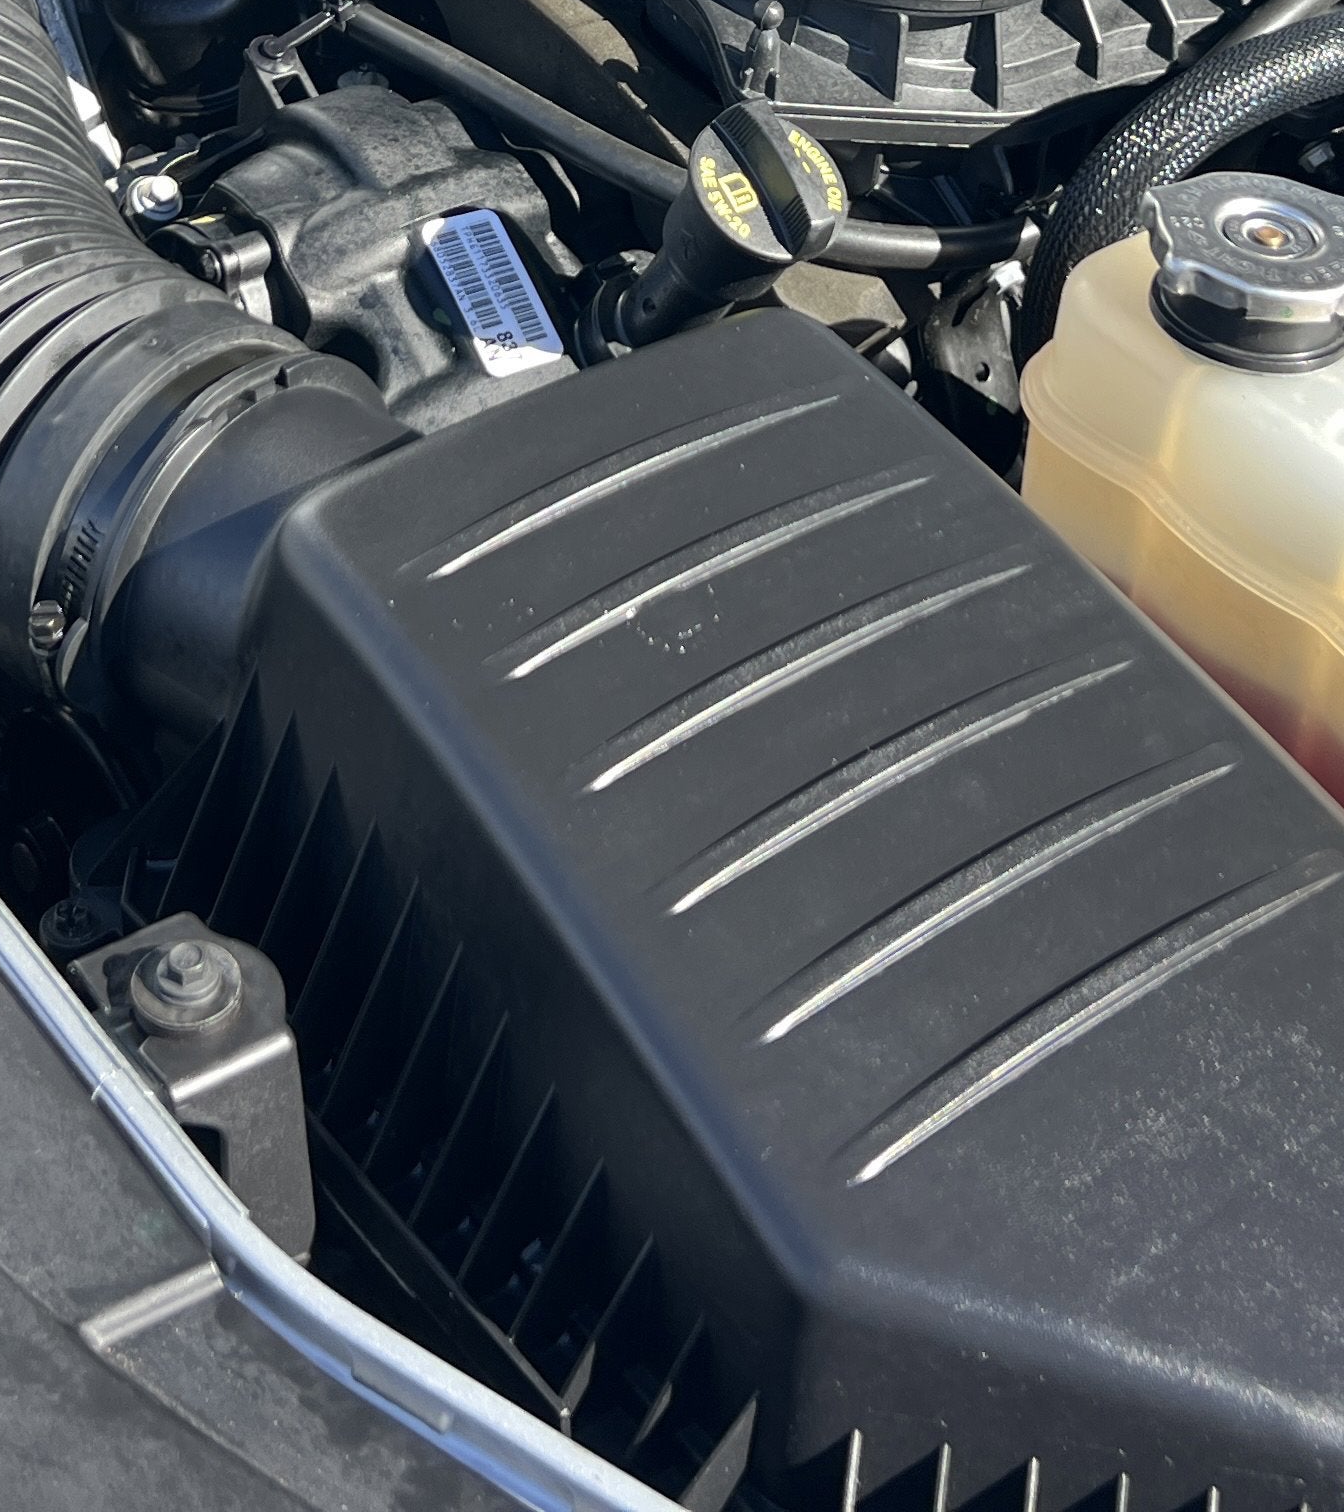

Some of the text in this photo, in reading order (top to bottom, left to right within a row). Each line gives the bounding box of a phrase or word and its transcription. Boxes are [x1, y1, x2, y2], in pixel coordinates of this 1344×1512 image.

[699, 156, 751, 238] SAE 5W-20
[788, 129, 843, 212] ENGINE OIL
